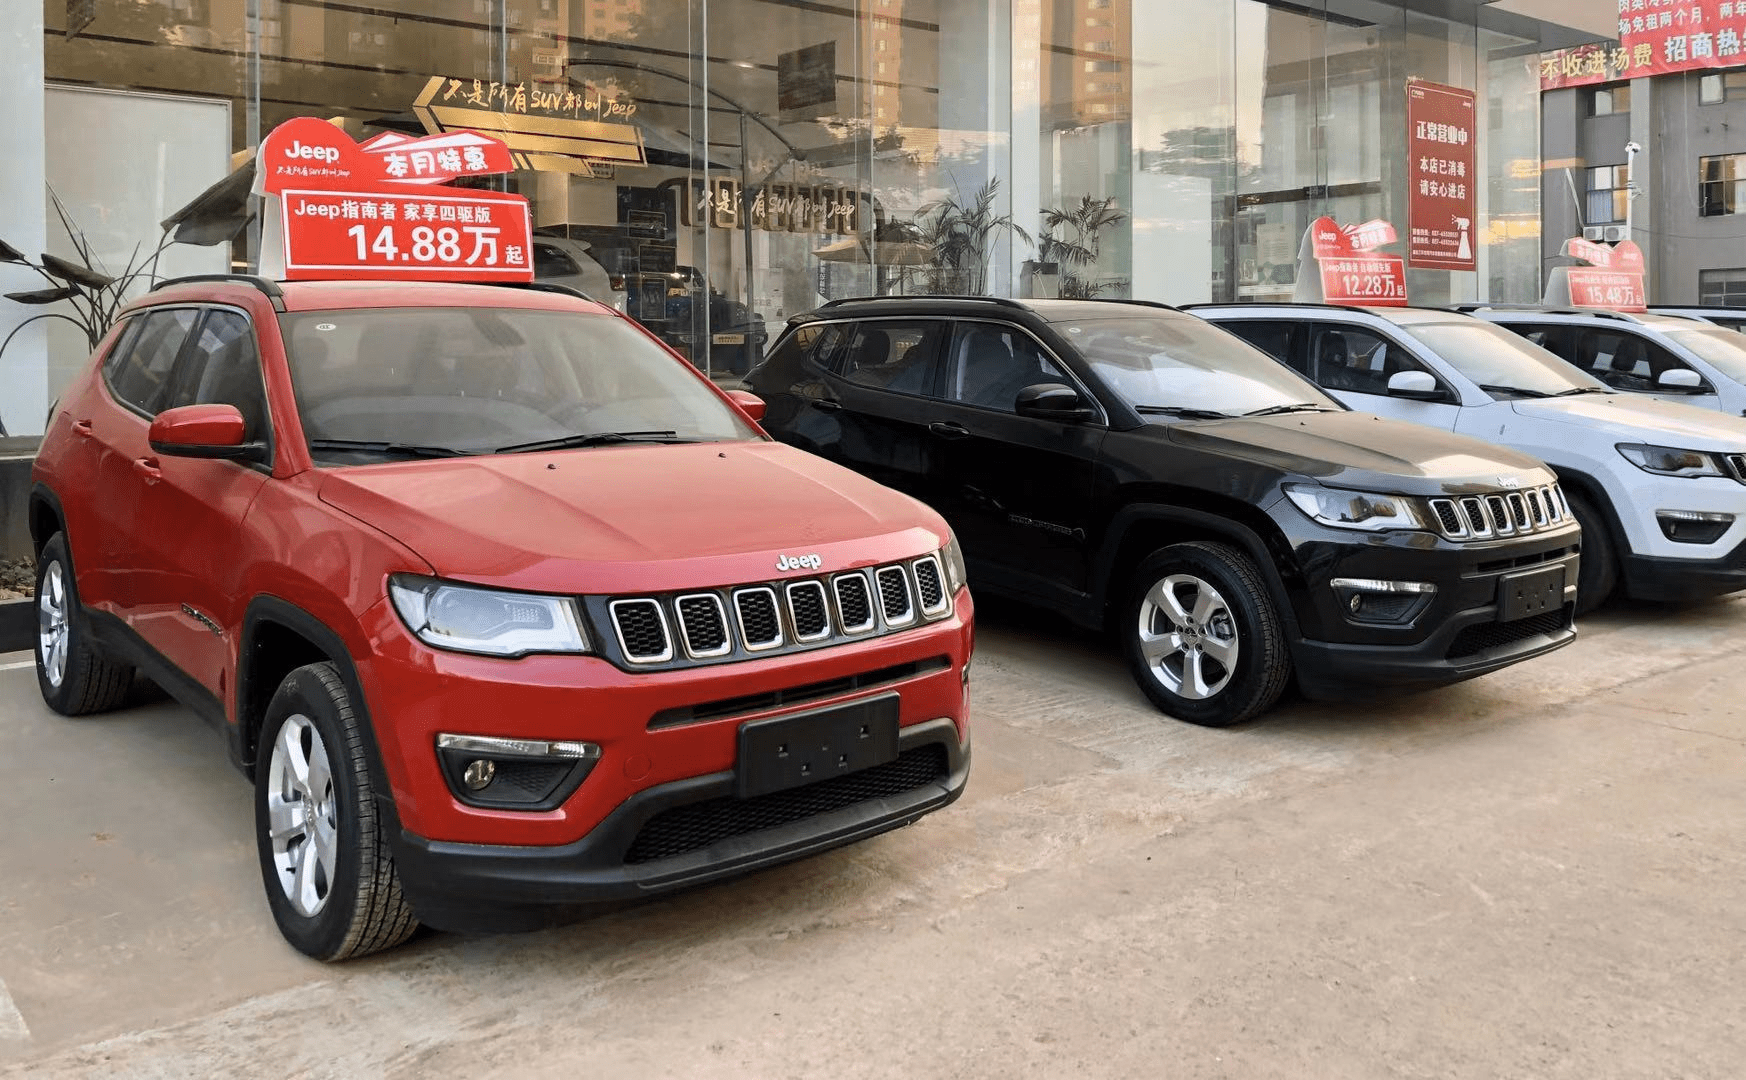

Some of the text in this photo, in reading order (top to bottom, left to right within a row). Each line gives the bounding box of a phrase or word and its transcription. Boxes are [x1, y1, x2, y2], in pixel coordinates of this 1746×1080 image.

[1541, 28, 1746, 80] 不收进场费 招商热
[1416, 120, 1468, 146] 正常营业中
[284, 140, 340, 164] Jeep
[384, 146, 489, 177] 本月特惠
[1419, 156, 1466, 178] 本店已消毒
[1419, 179, 1466, 200] 请安心进店
[294, 200, 491, 223] Jeep指南者 家享四驱版
[348, 224, 525, 266] 14.88万 起
[1342, 273, 1396, 297] 12.28万
[775, 554, 822, 571] Jeep
